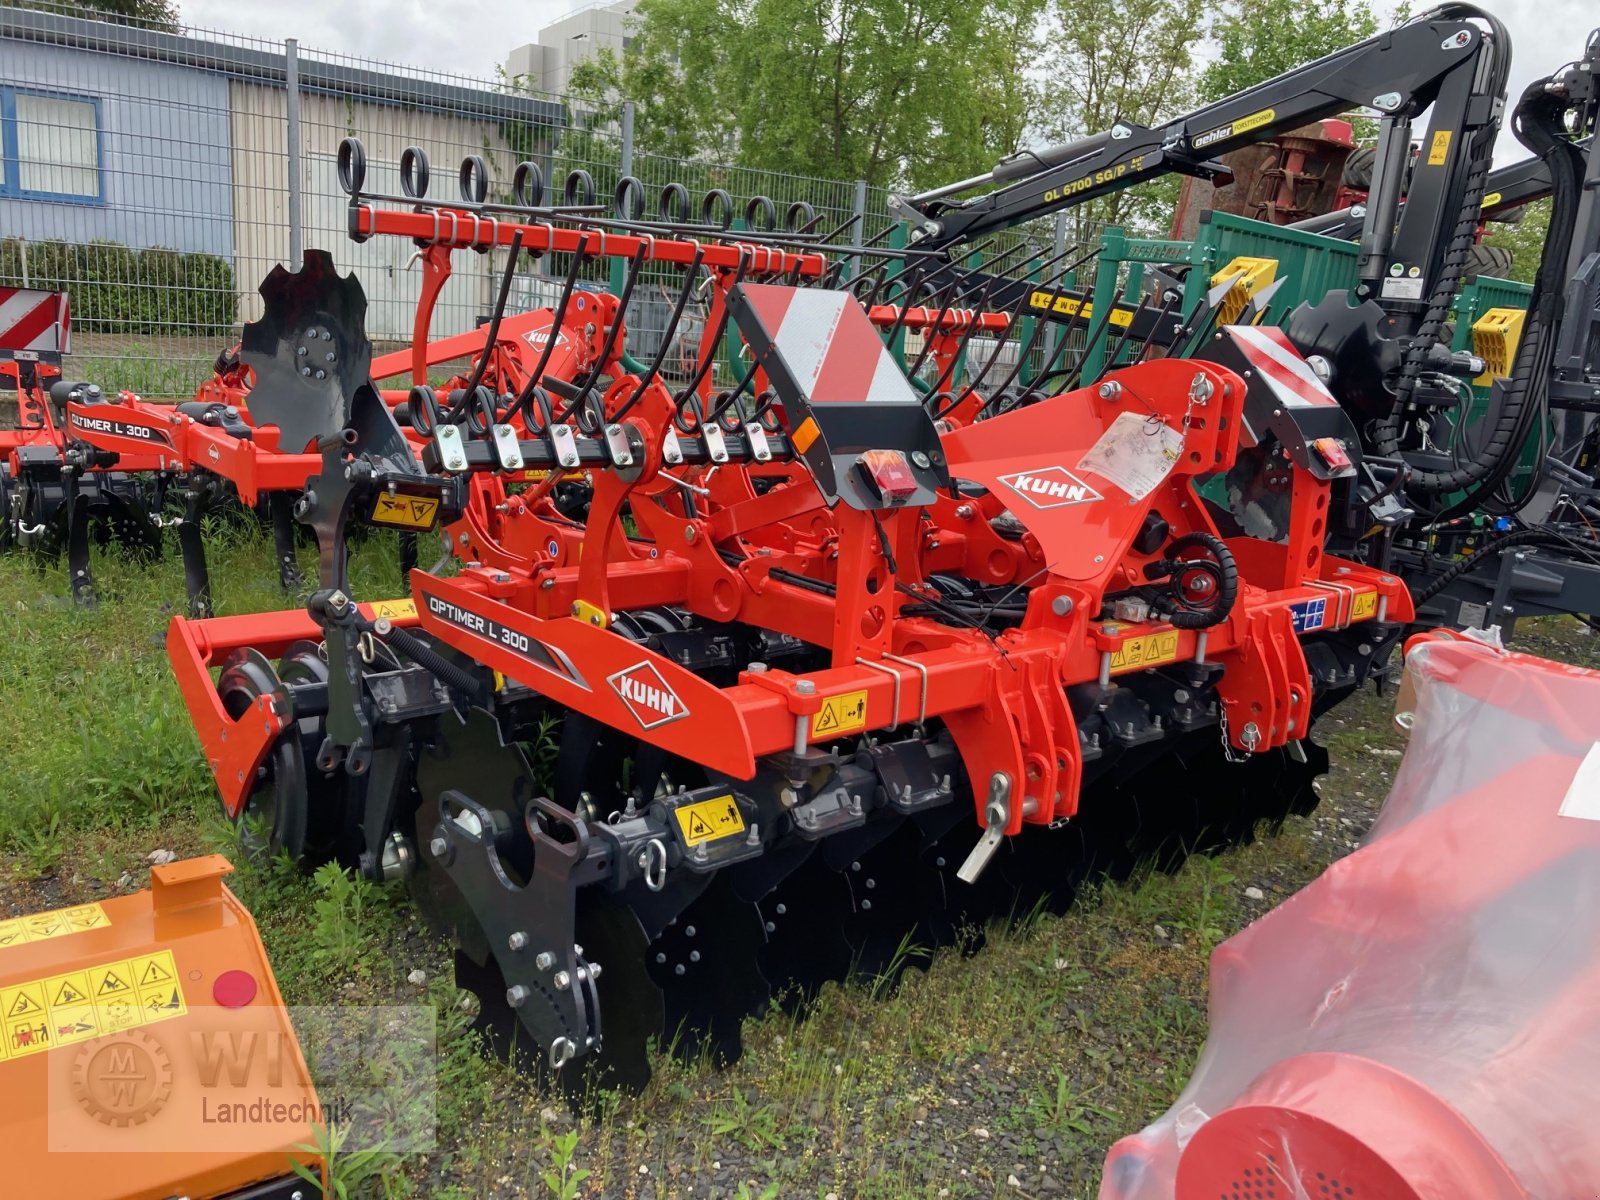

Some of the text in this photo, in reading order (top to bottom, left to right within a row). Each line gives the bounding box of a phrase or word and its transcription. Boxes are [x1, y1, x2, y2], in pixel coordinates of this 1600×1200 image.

[1195, 112, 1272, 147] oehler FORSTTECHNIK
[1044, 190, 1060, 202] OL
[1063, 177, 1092, 195] 6700
[1095, 164, 1126, 184] SG/P
[115, 421, 123, 434] L
[126, 424, 150, 439] 300
[1013, 475, 1087, 501] KUHN
[429, 596, 529, 653] OPTIMER L 300
[620, 674, 675, 717] KUHN
